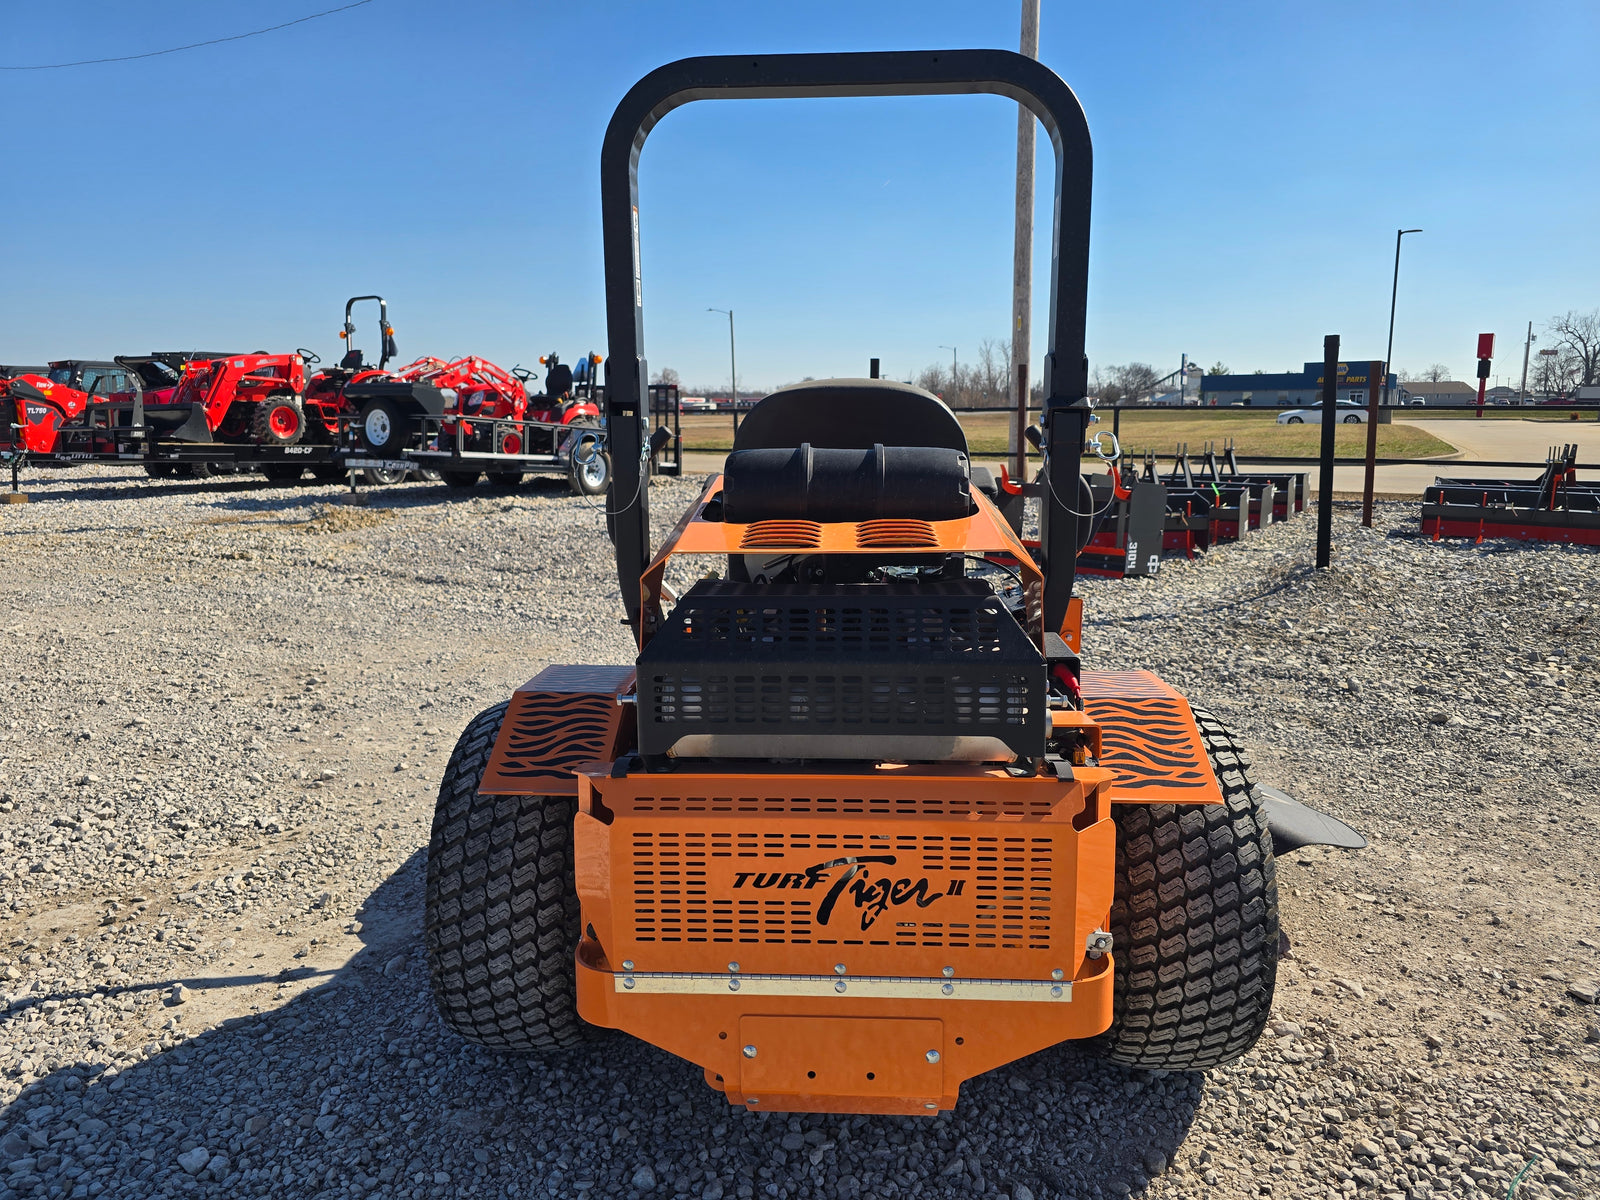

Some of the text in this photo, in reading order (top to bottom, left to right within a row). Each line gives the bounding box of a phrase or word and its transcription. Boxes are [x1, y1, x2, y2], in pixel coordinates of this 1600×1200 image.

[733, 855, 967, 931] TURF Tiger II
